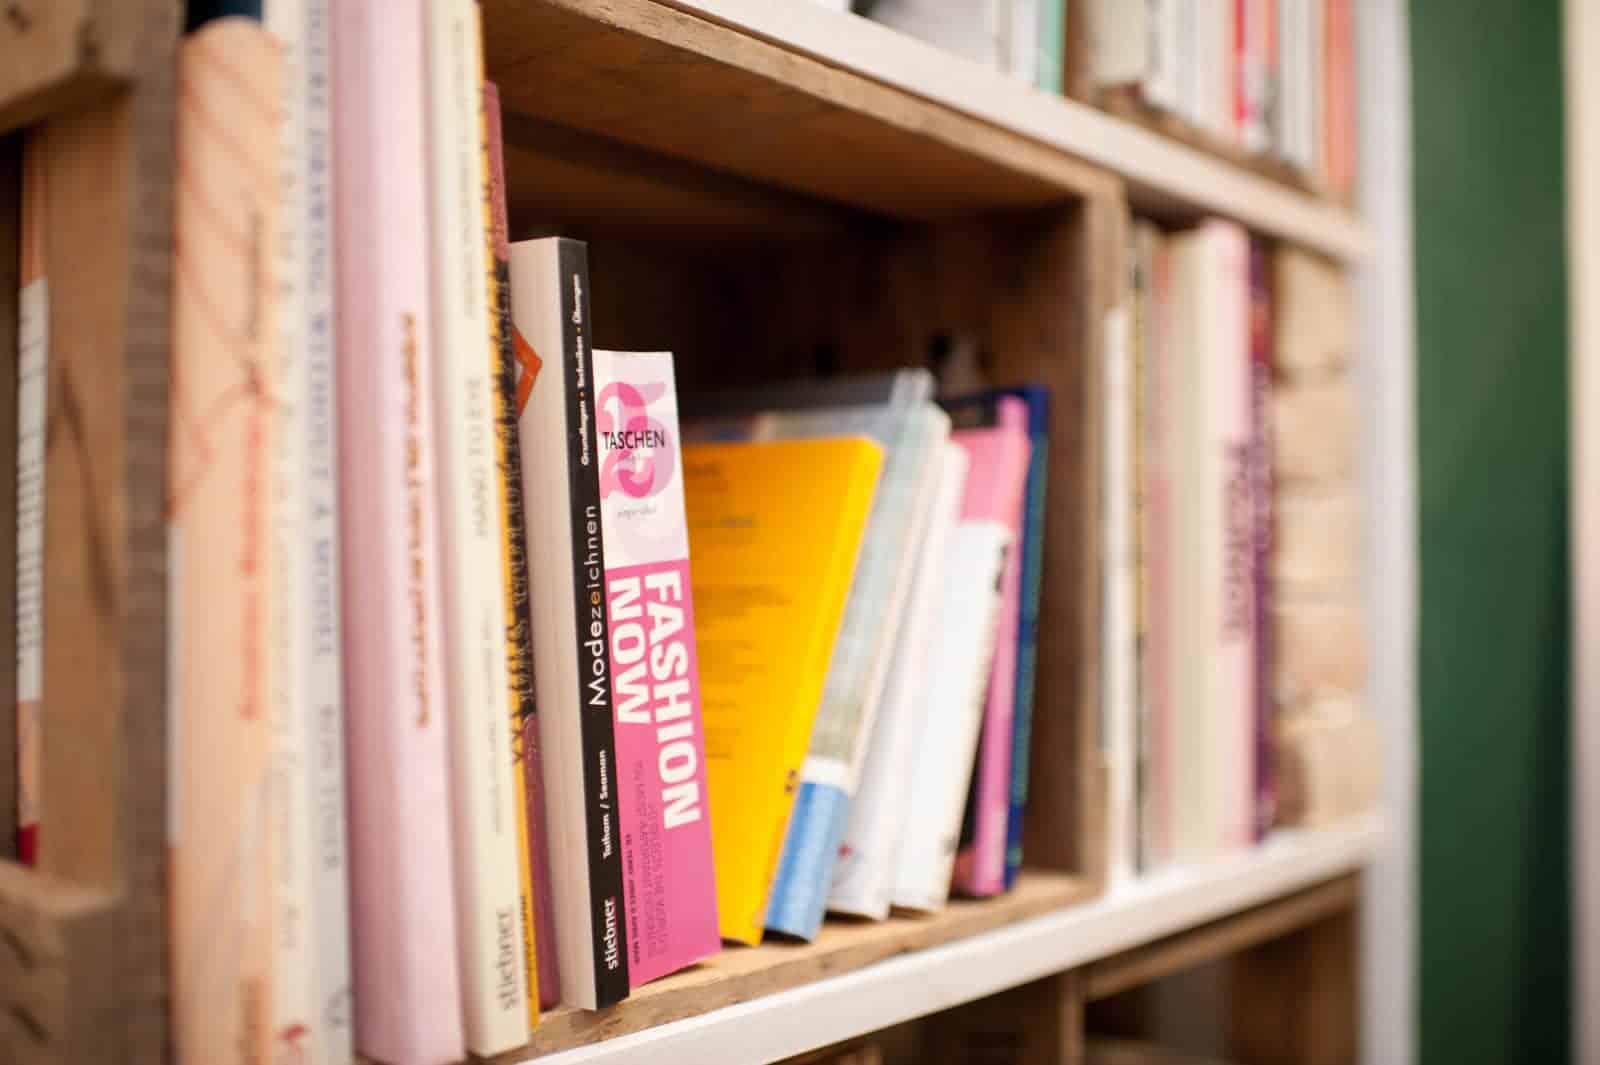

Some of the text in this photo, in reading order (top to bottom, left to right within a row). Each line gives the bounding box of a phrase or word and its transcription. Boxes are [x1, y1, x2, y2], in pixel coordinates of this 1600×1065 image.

[602, 430, 665, 449] TASCHEN
[583, 505, 606, 704] Modezeichnen
[609, 578, 651, 724] NOW
[645, 572, 701, 827] FASHION
[598, 749, 609, 800] Seaman
[600, 813, 613, 859] Tatham
[496, 909, 515, 1012] stiebner
[603, 898, 616, 969] stiebner
